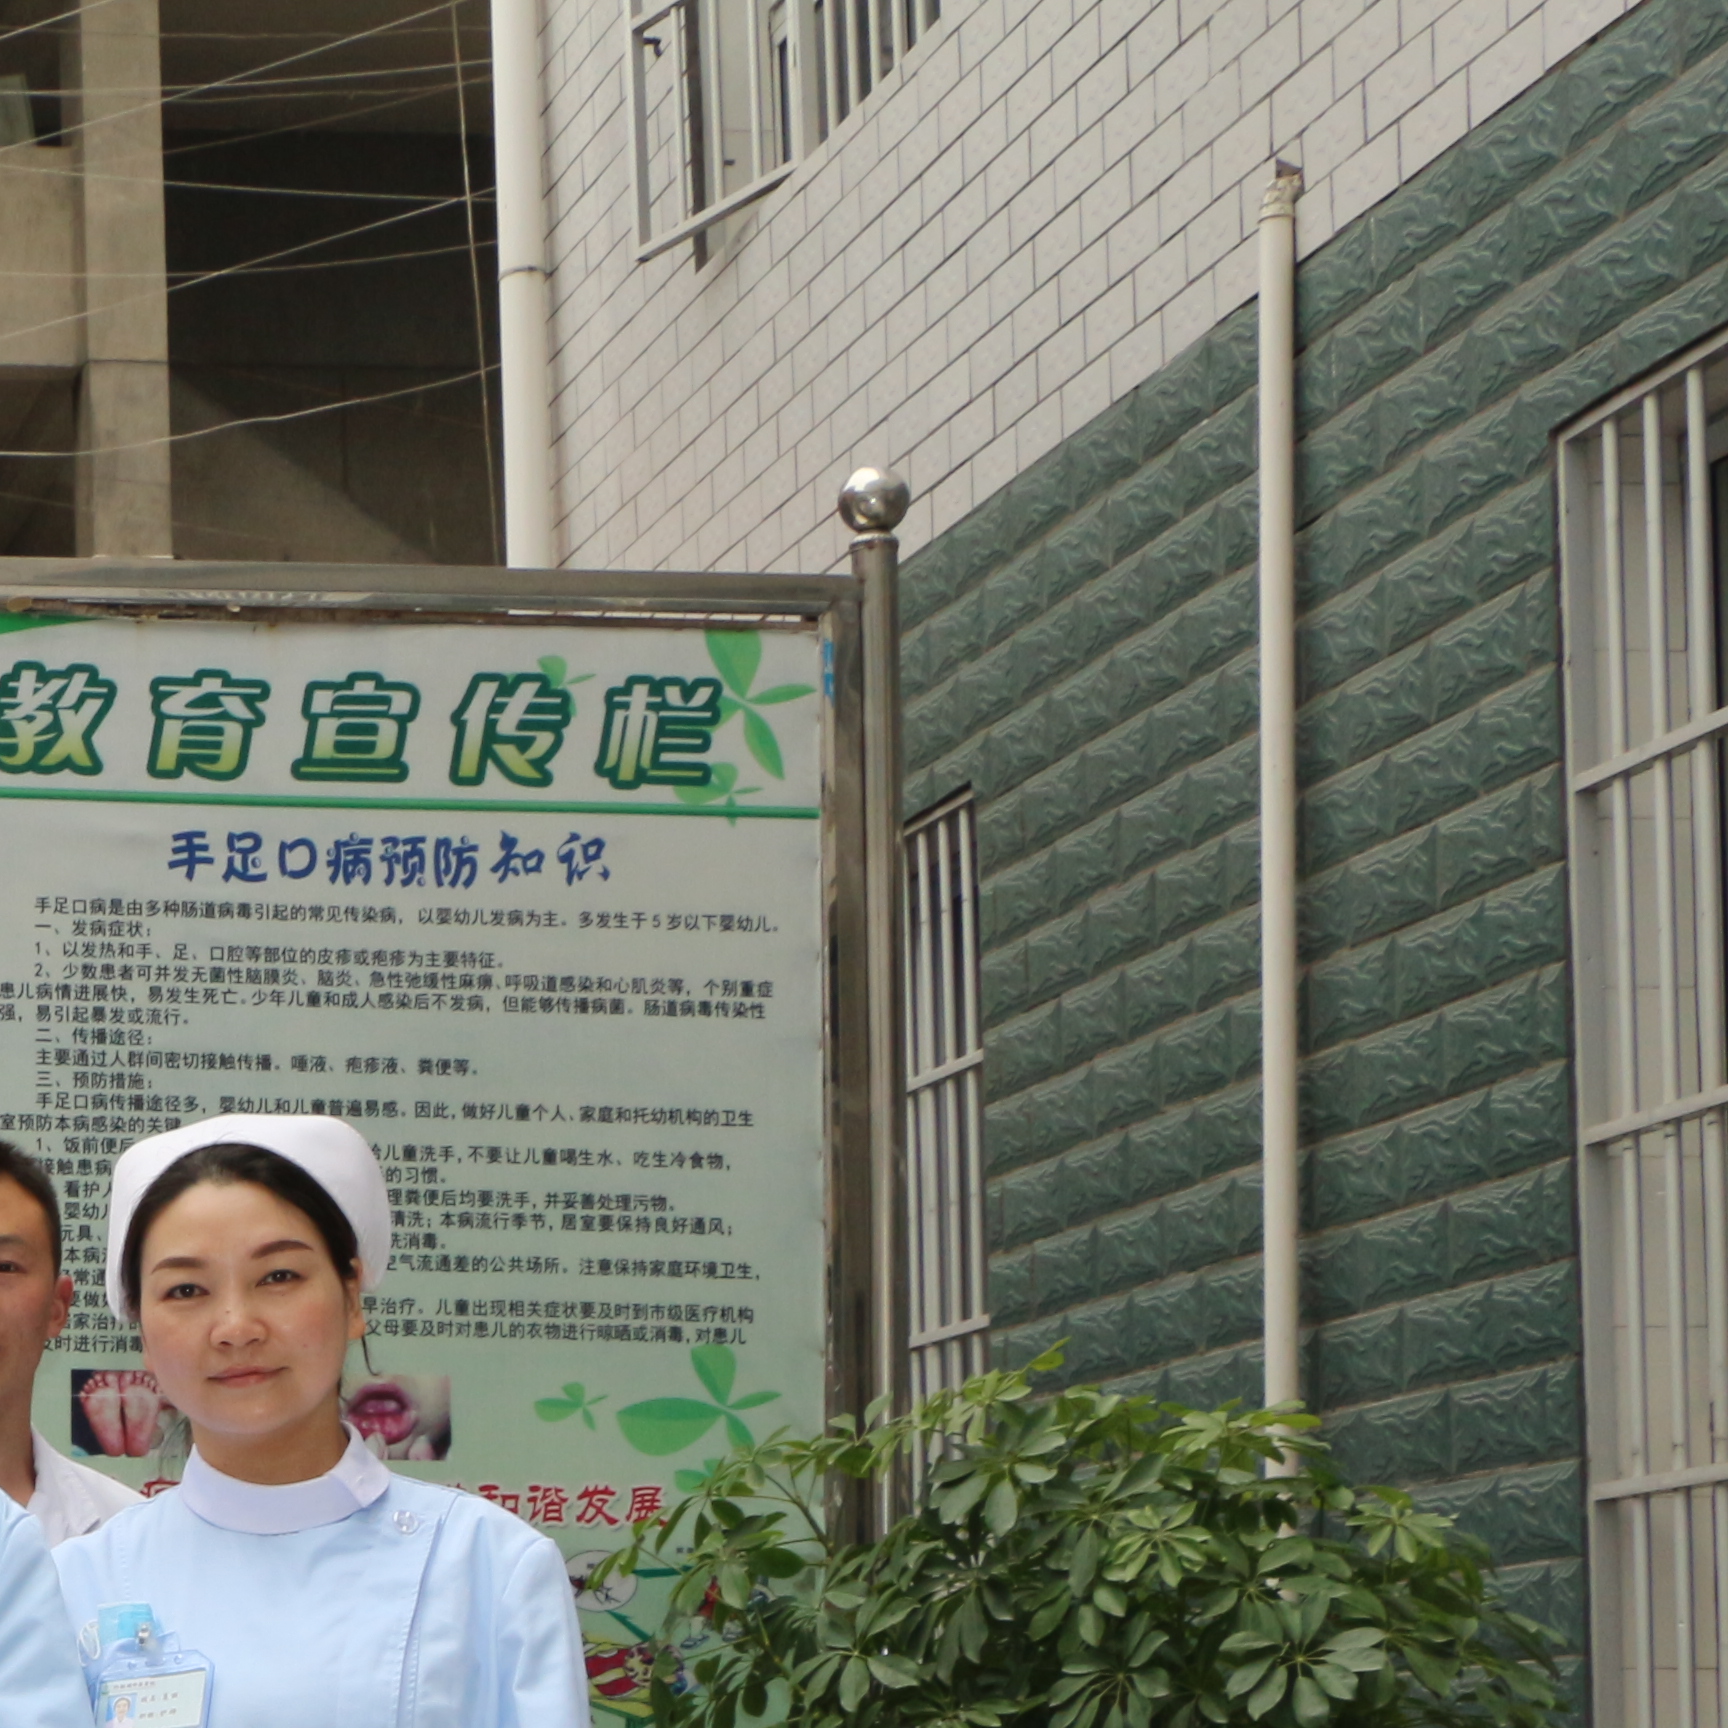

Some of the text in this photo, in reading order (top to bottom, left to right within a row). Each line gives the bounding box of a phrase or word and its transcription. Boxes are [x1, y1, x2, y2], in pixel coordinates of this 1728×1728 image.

[166, 829, 612, 889] 手足口病预防知识
[380, 1166, 447, 1185] 的习惯。
